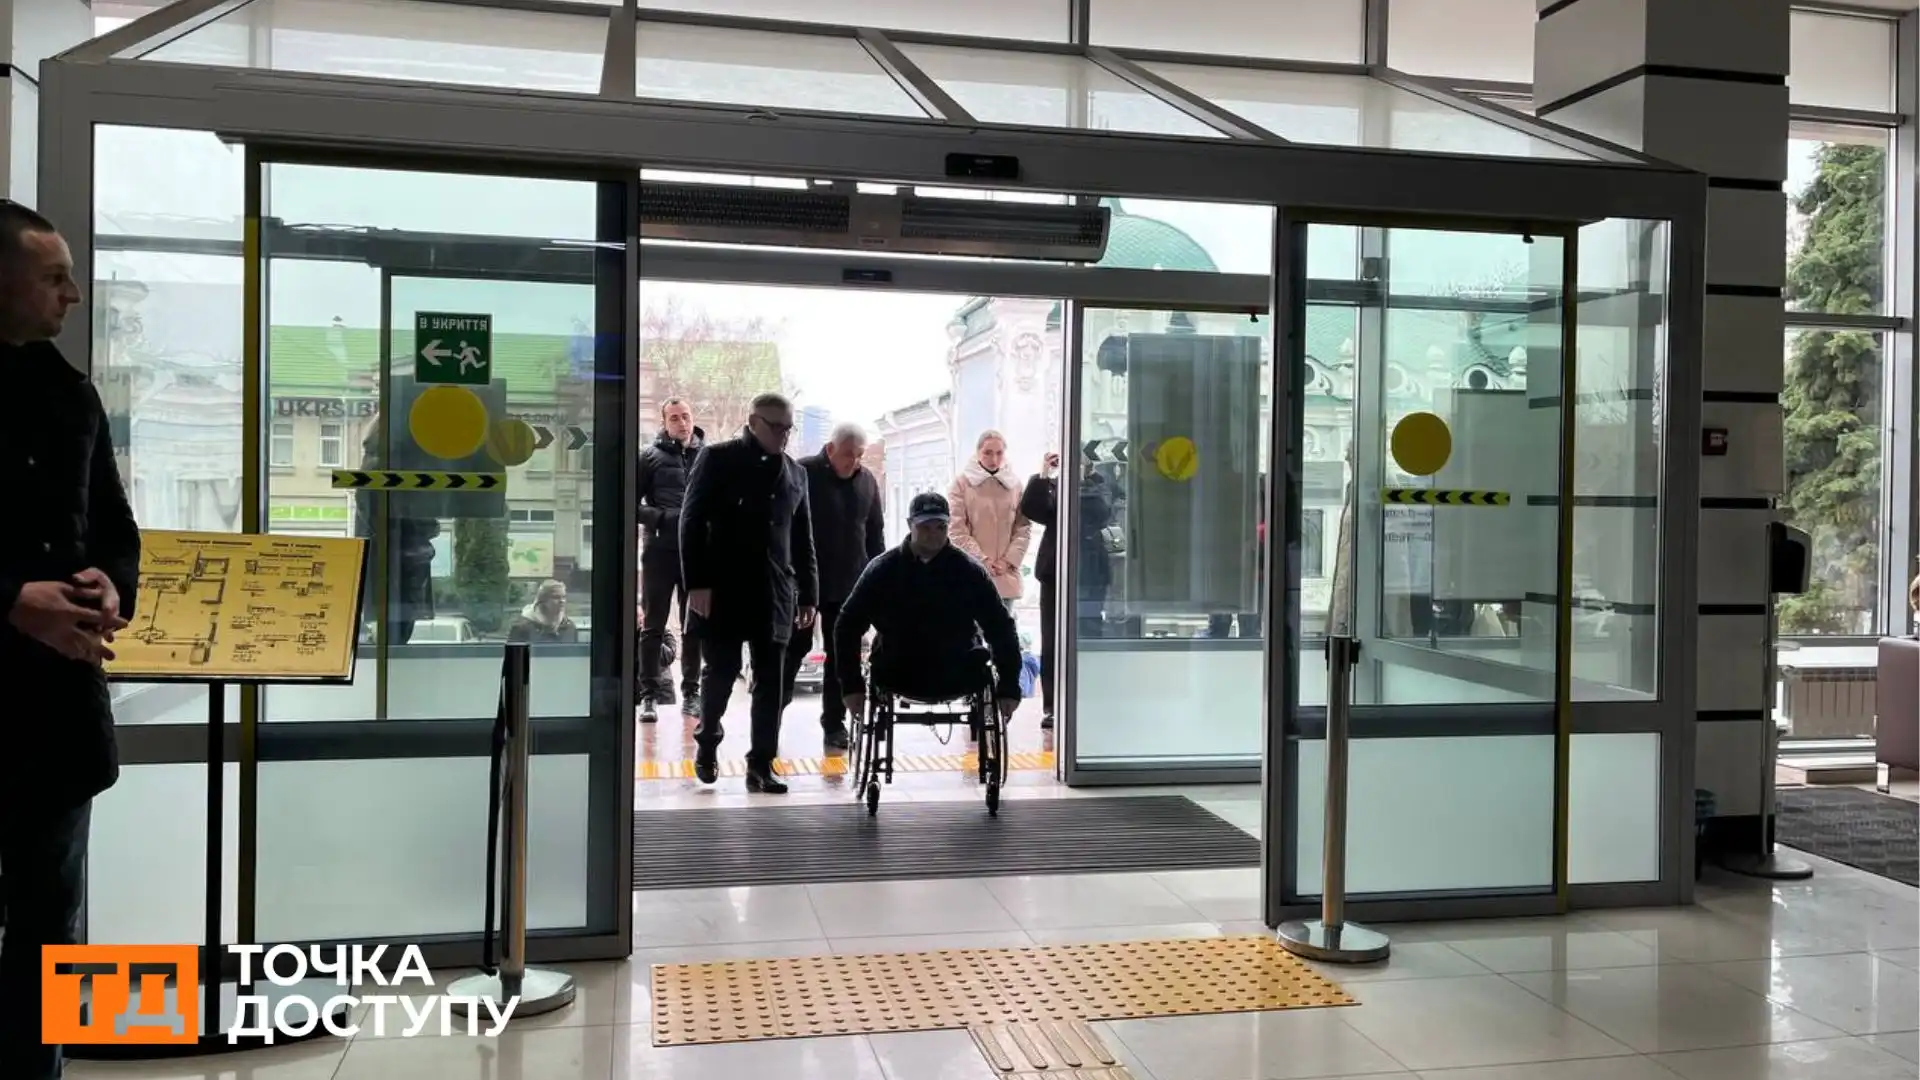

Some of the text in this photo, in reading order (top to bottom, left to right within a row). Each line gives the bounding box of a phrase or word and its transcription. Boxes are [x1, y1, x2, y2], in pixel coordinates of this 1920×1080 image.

[419, 317, 488, 332] В УКРИТТЯ
[276, 399, 380, 418] UKRSIB
